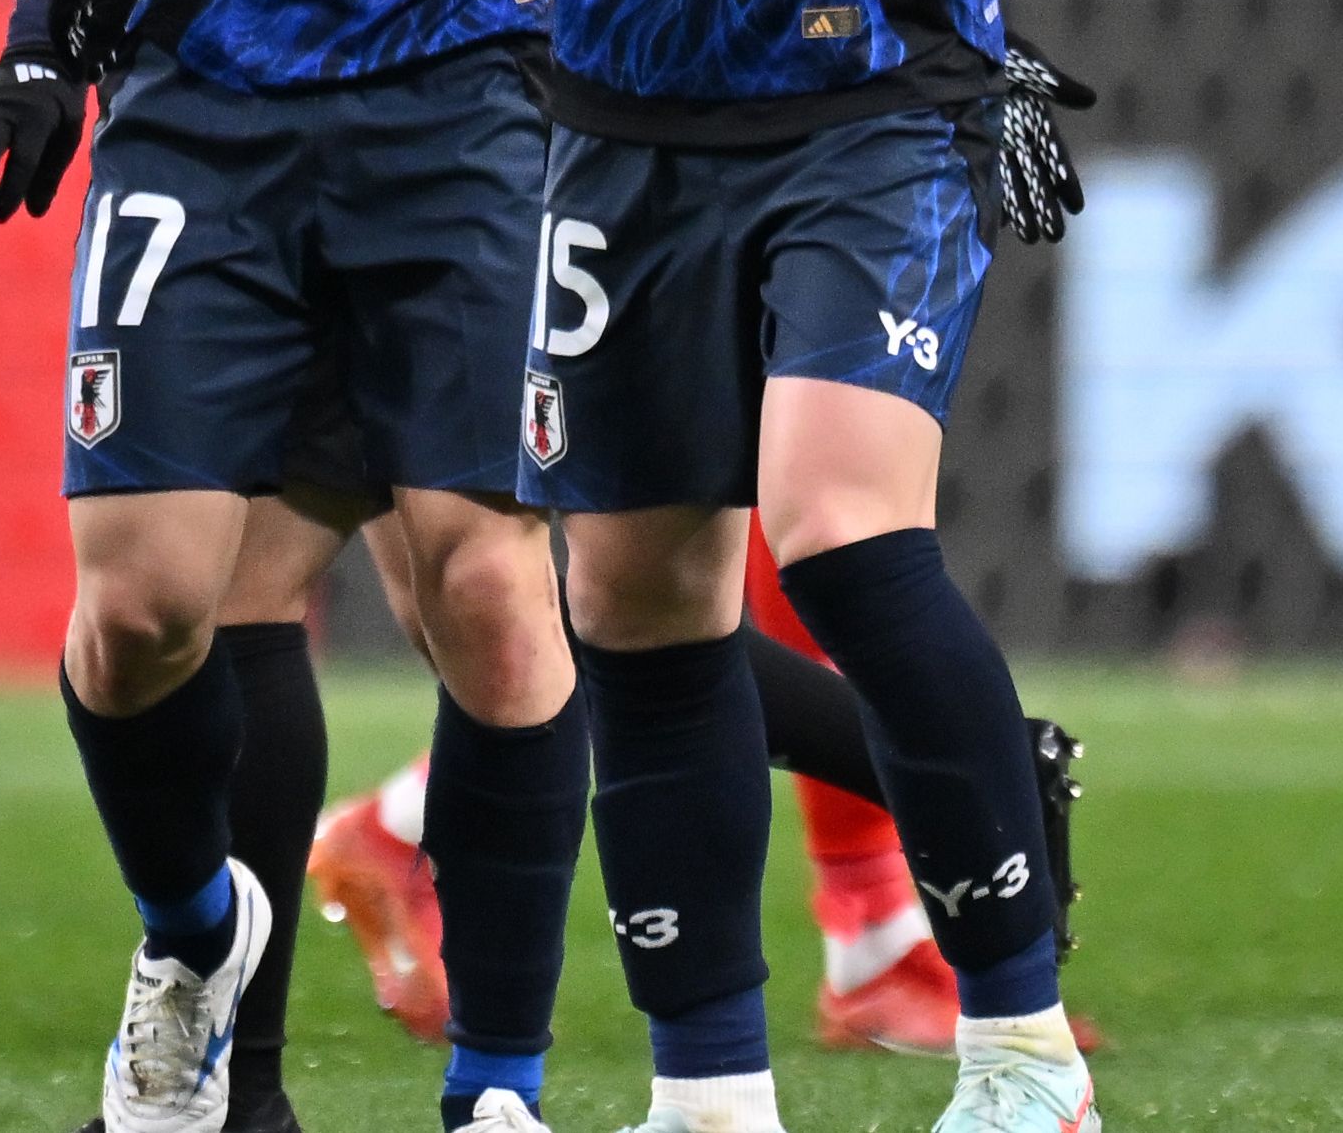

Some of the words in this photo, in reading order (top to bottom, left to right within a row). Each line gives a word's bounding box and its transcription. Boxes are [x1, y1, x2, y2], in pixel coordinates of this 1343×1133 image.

[79, 191, 186, 329] 17
[532, 211, 610, 357] 15
[878, 310, 940, 372] Y-3
[919, 852, 1031, 918] Y-3
[608, 907, 680, 950] -3
